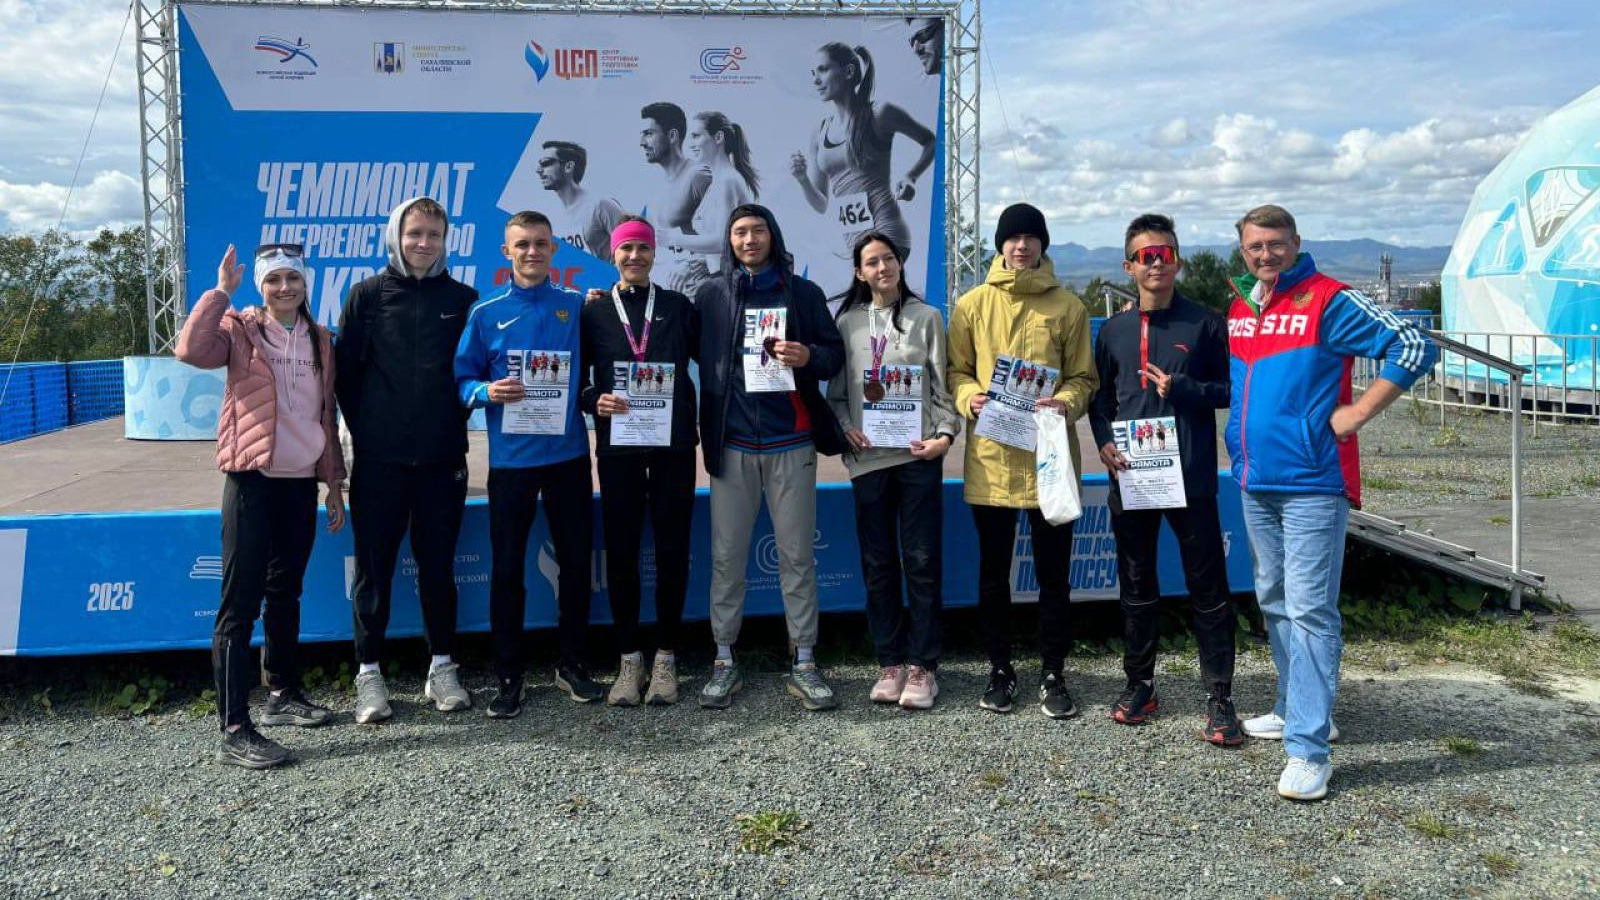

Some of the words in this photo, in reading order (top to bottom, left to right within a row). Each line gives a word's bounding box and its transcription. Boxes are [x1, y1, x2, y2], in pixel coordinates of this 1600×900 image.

[554, 48, 598, 80] ЦСП
[257, 161, 475, 218] ЧЕМПИОНАТ
[839, 202, 871, 226] 462
[871, 402, 913, 411] ГРАМОТА
[1130, 458, 1171, 468] РАМОТА
[1069, 558, 1118, 590] ОССУ
[86, 581, 136, 612] 2025
